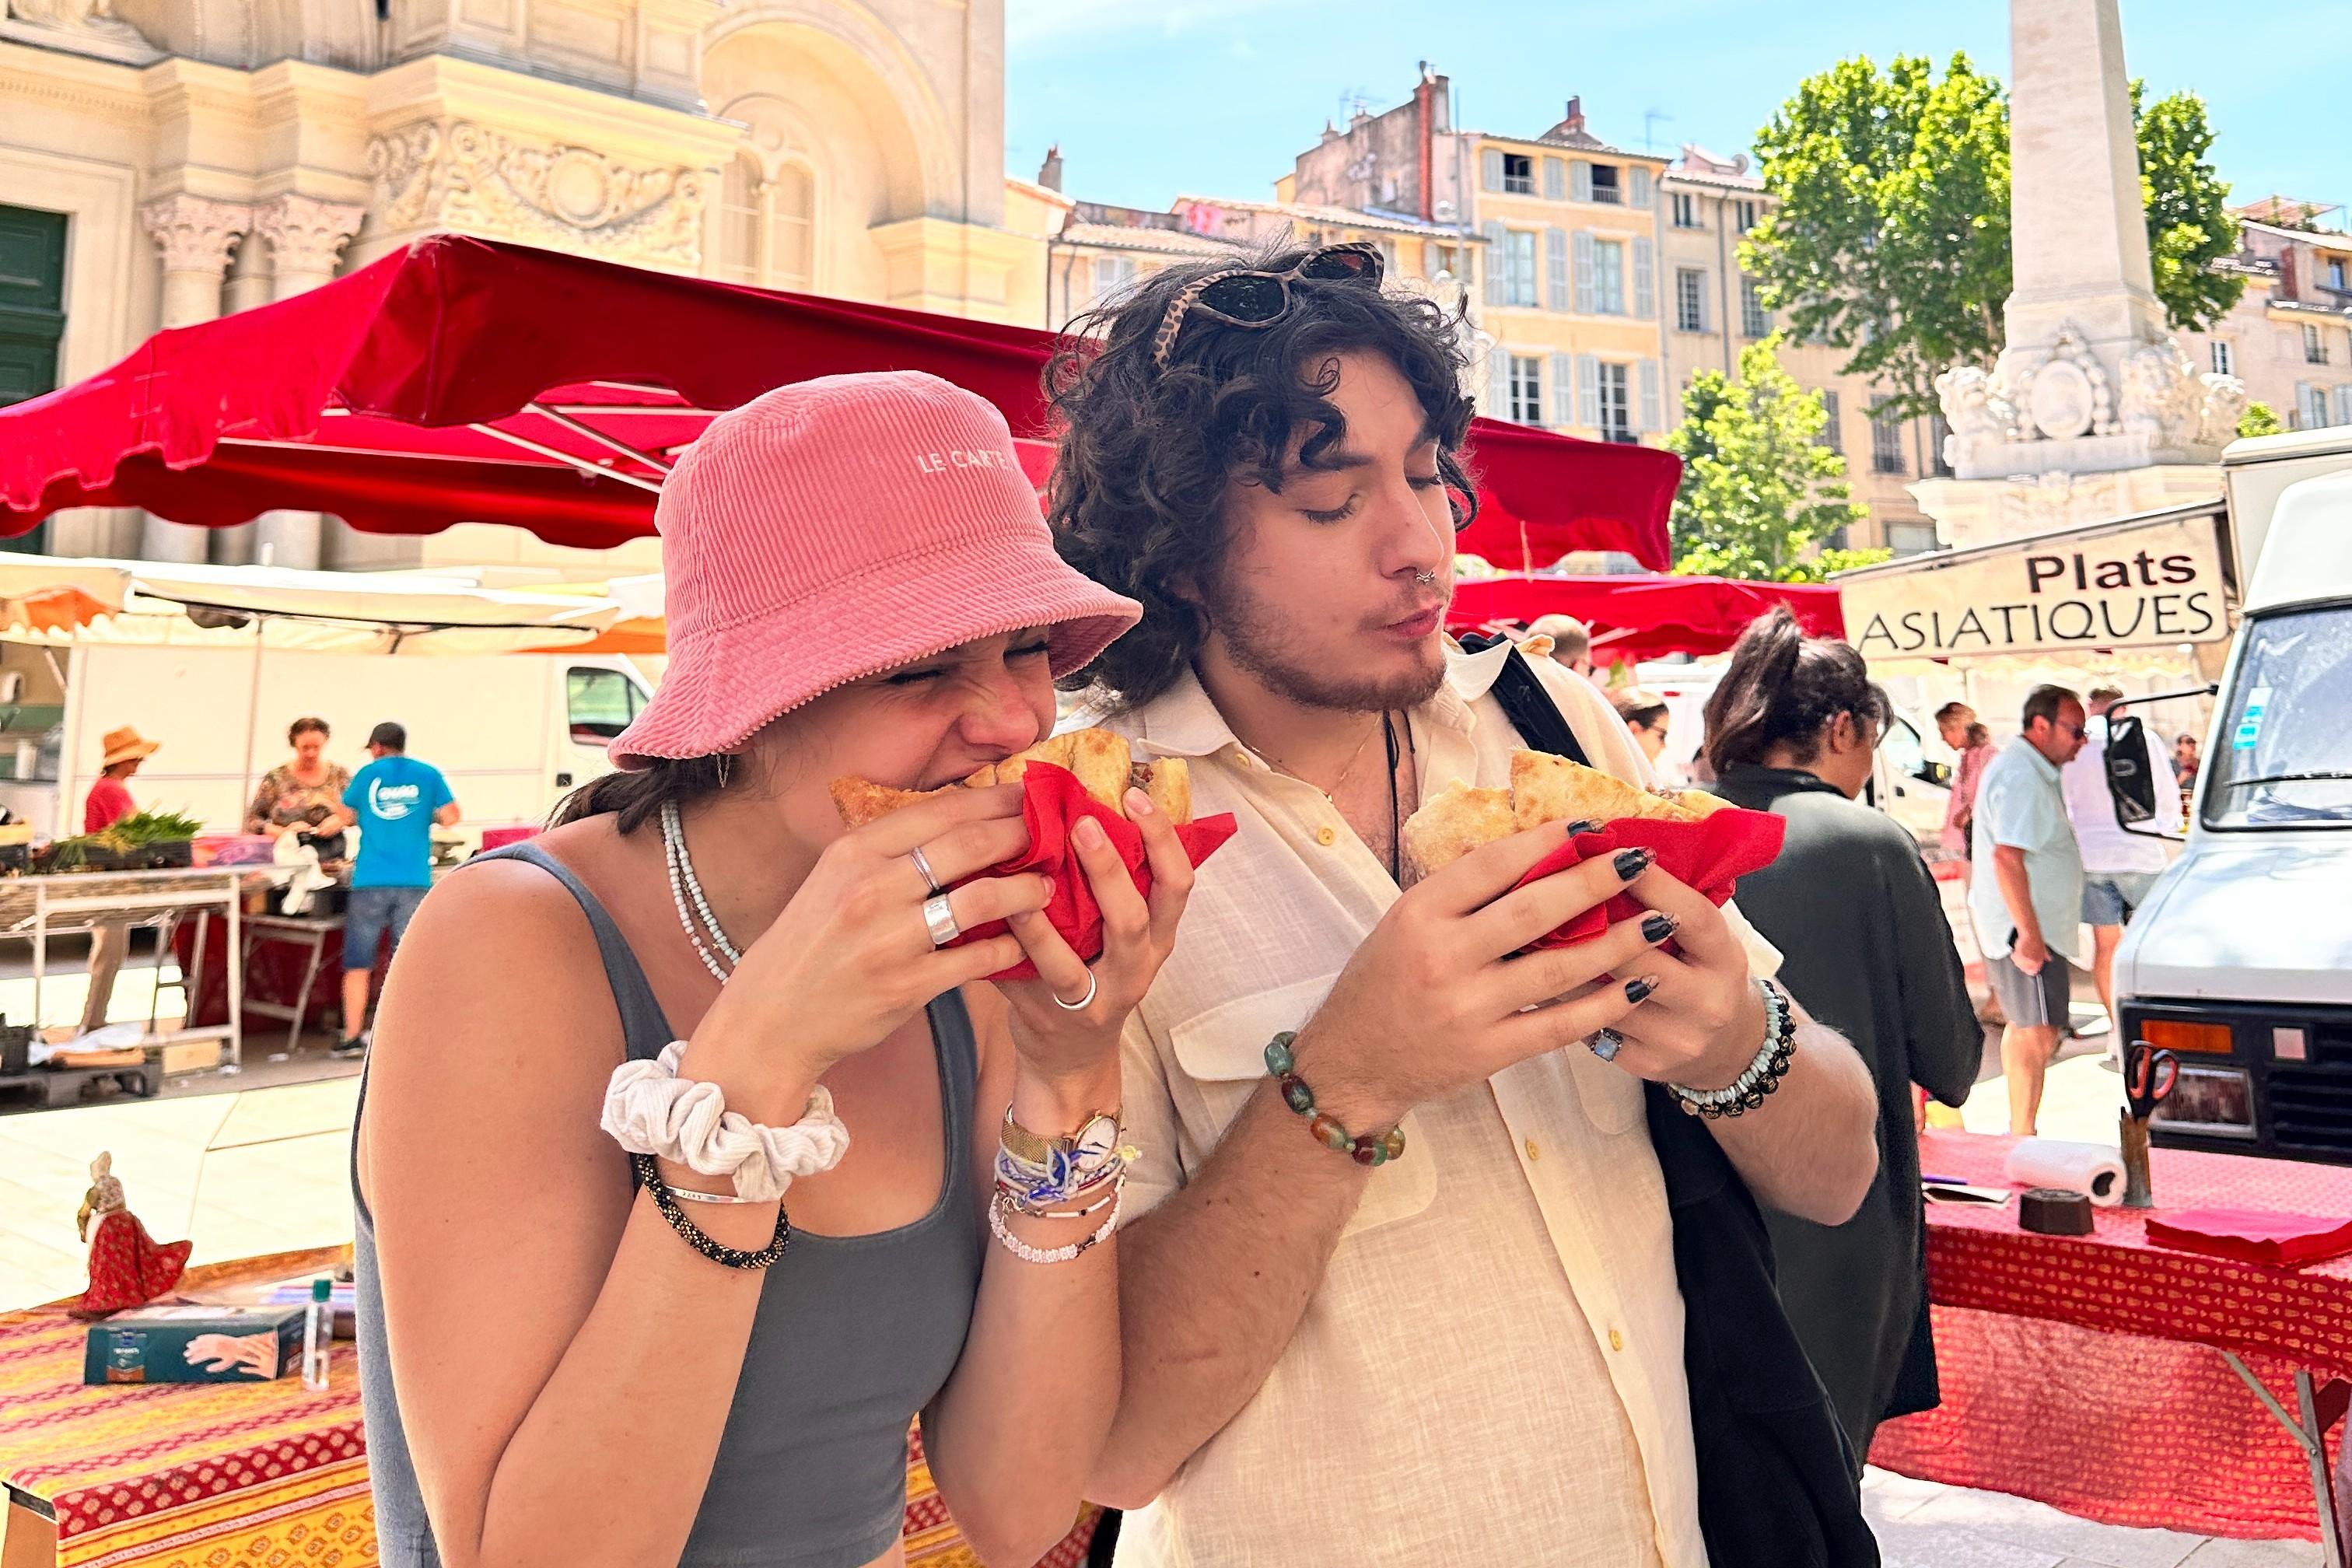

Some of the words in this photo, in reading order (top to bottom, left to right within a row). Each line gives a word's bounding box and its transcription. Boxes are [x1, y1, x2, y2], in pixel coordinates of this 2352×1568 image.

[918, 453, 947, 474] LE
[2025, 549, 2197, 593] Plats
[1858, 592, 2213, 653] ASIATIQUES
